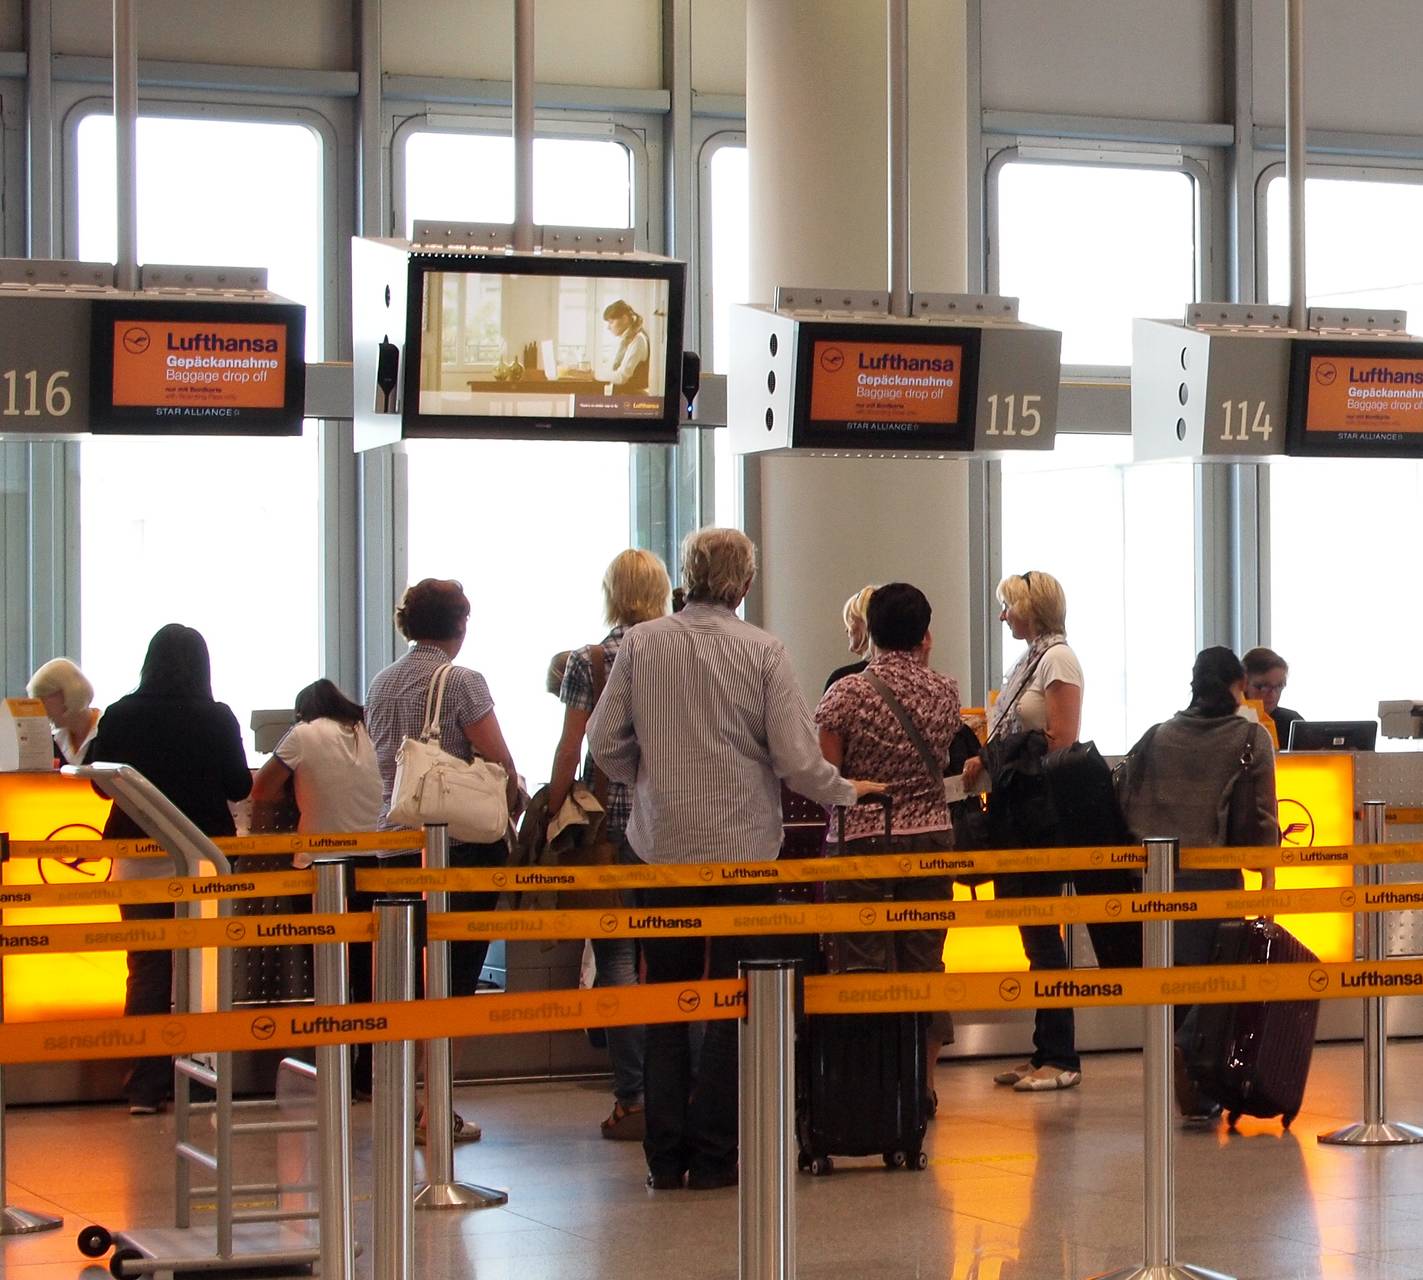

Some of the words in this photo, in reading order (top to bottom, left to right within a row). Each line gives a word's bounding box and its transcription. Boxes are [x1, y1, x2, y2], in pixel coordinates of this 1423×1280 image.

[167, 333, 278, 353] Lufthansa
[167, 355, 278, 370] Gepäckannahme
[859, 353, 954, 372] Lufthansa
[166, 370, 219, 383] Baggage
[223, 370, 250, 384] drop
[253, 370, 267, 382] off
[858, 374, 953, 388] Gepäckannahme
[3, 370, 71, 416] 116
[857, 387, 902, 400] Baggage
[904, 388, 928, 401] drop
[931, 389, 944, 399] off
[1347, 399, 1388, 411] Baggage
[1391, 400, 1411, 412] drop
[156, 408, 181, 416] STAR
[184, 408, 233, 417] ALLIANCE
[985, 394, 1041, 436] 115
[870, 423, 912, 431] ALLIANCE
[1220, 400, 1272, 441] 114
[1338, 432, 1358, 440] STAR
[1360, 433, 1397, 441] ALLIANCE
[135, 844, 165, 853] Lufth
[308, 838, 357, 848] Lufthansa
[1111, 853, 1147, 863] Luftha
[1300, 851, 1348, 861] Lufthansa
[919, 859, 974, 870] Lufthansa
[721, 867, 778, 878] Lufthansa
[515, 874, 574, 885] Lufthansa
[192, 881, 255, 894] Lufthansa
[1131, 900, 1197, 913] Lufthansa
[887, 908, 955, 922] Lufthansa
[628, 916, 701, 929] Lufthansa
[257, 923, 335, 937] Lufthansa
[0, 934, 49, 946] hansa
[1340, 970, 1423, 987] Lufthansa
[1034, 981, 1122, 998] Lufthansa
[291, 1014, 387, 1035] Lufthansa
